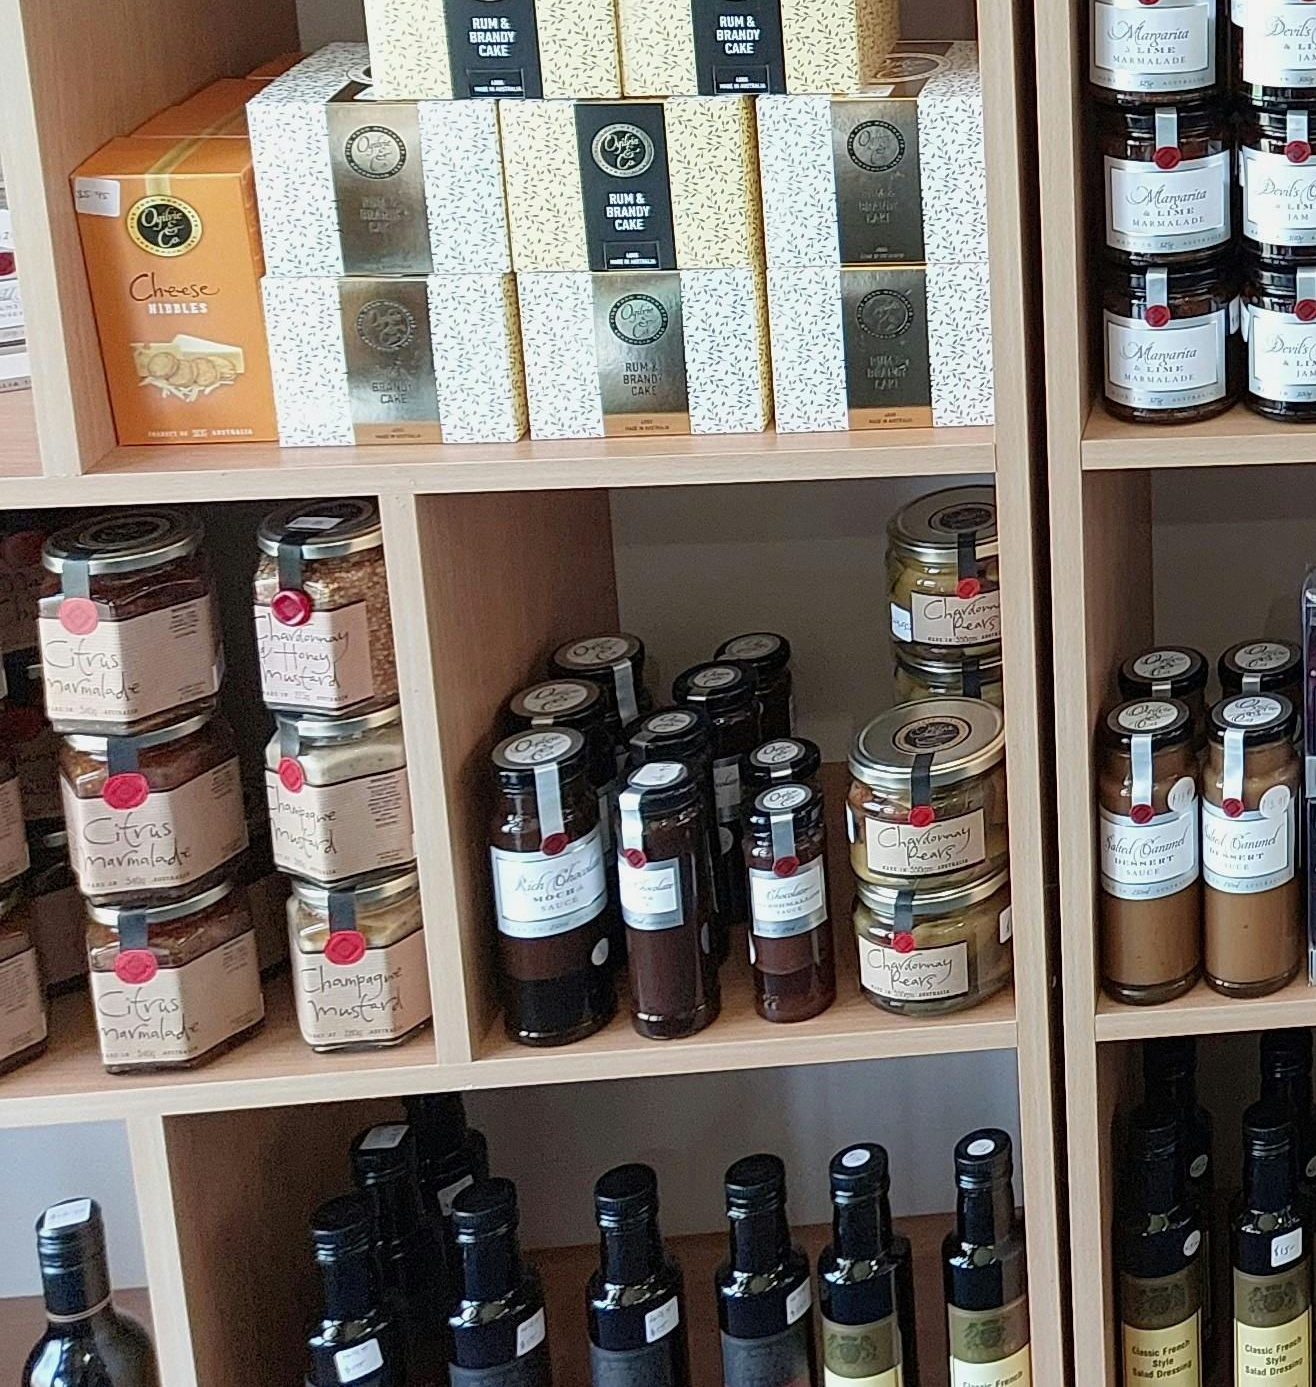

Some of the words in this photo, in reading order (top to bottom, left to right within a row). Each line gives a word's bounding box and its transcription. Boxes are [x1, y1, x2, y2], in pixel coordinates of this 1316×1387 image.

[472, 17, 496, 31] RUM
[498, 17, 509, 30] &
[719, 15, 743, 28] RUM
[745, 16, 755, 28] &
[1265, 17, 1311, 37] Devil's
[469, 30, 516, 44] BRANDY
[716, 28, 760, 42] BRANDY
[1108, 21, 1190, 43] Margarita
[479, 43, 509, 57] CAKE
[725, 42, 755, 55] CAKE
[1136, 46, 1176, 55] LIME
[1113, 56, 1188, 65] MARMALADE
[129, 272, 220, 301] Cheese
[148, 303, 209, 316] NIBBLES
[276, 643, 331, 671] Honey
[83, 813, 172, 846] Citrus
[877, 824, 971, 850] Chardonnay
[1138, 832, 1186, 857] Caramel
[905, 843, 955, 866] Pears
